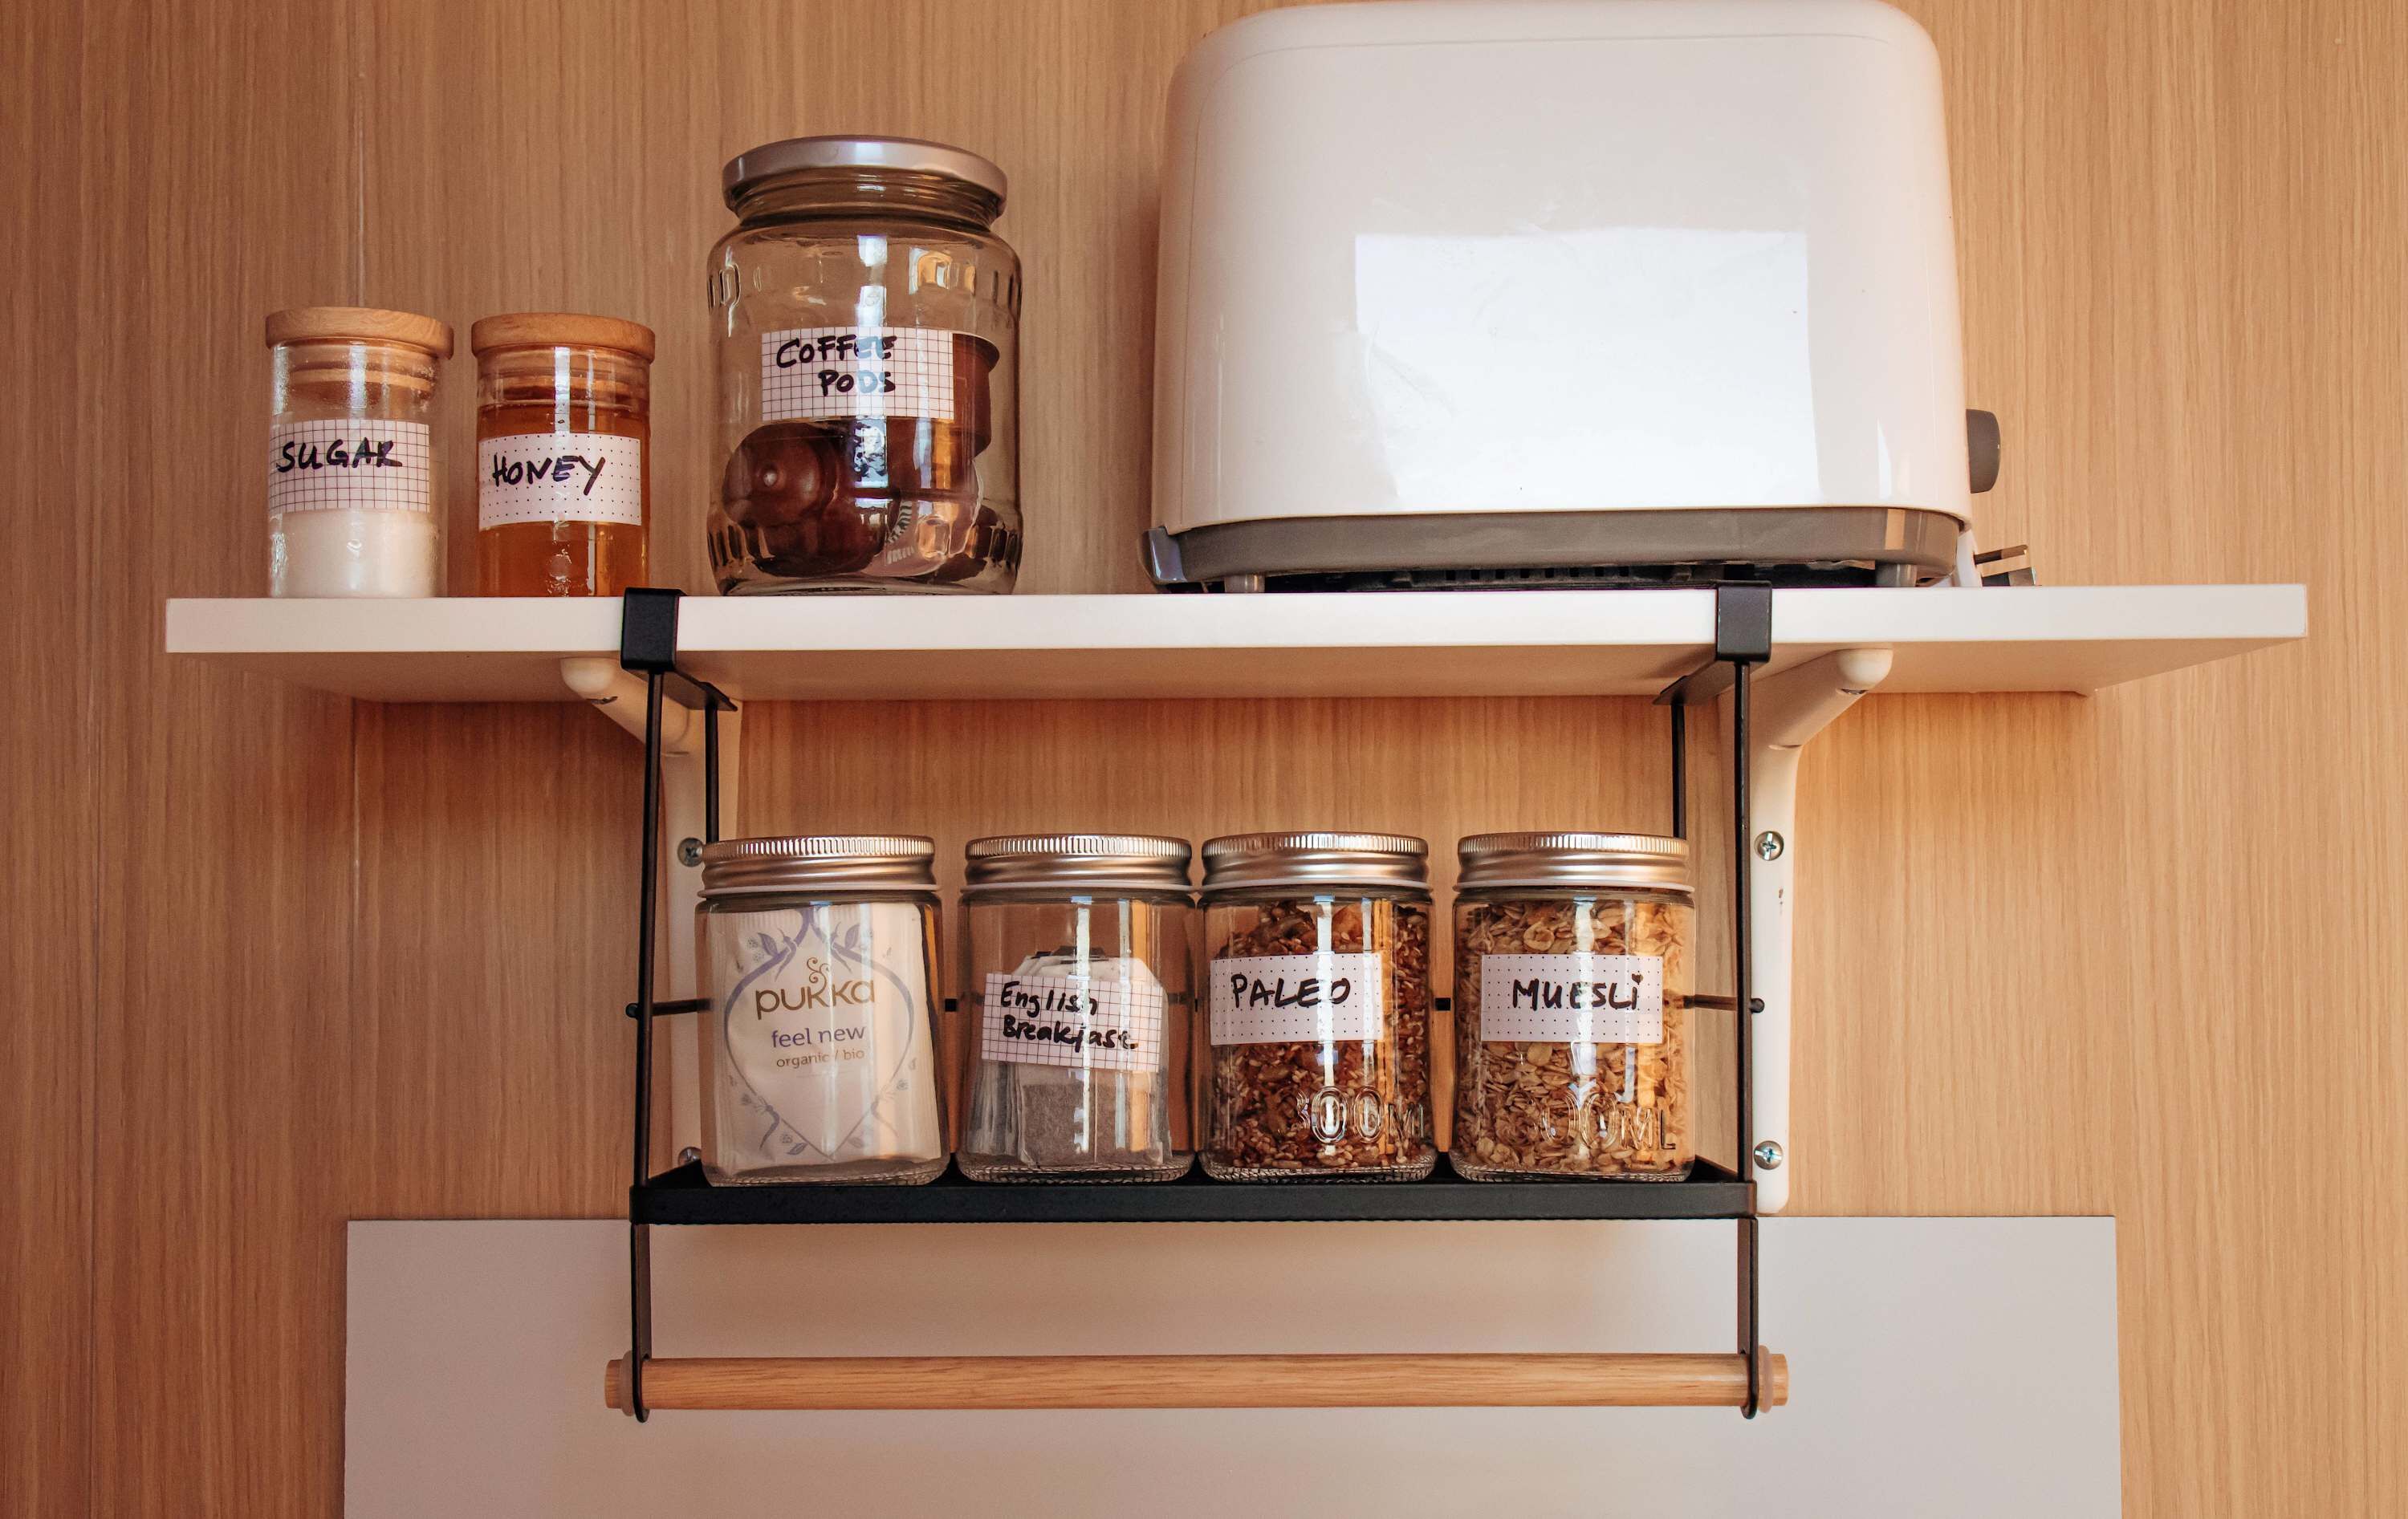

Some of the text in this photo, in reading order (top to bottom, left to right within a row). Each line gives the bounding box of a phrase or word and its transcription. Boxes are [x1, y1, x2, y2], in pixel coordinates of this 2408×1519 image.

[776, 334, 897, 368] COFFEE
[818, 369, 896, 397] PODS
[276, 437, 403, 473] SUGAR
[492, 445, 606, 496] HONEY
[755, 957, 875, 1021] pukka
[1000, 981, 1098, 1017] English
[1230, 973, 1351, 1009] PALEO
[771, 1026, 867, 1048] feel new
[776, 1051, 830, 1069] organic
[843, 1048, 865, 1060] bio
